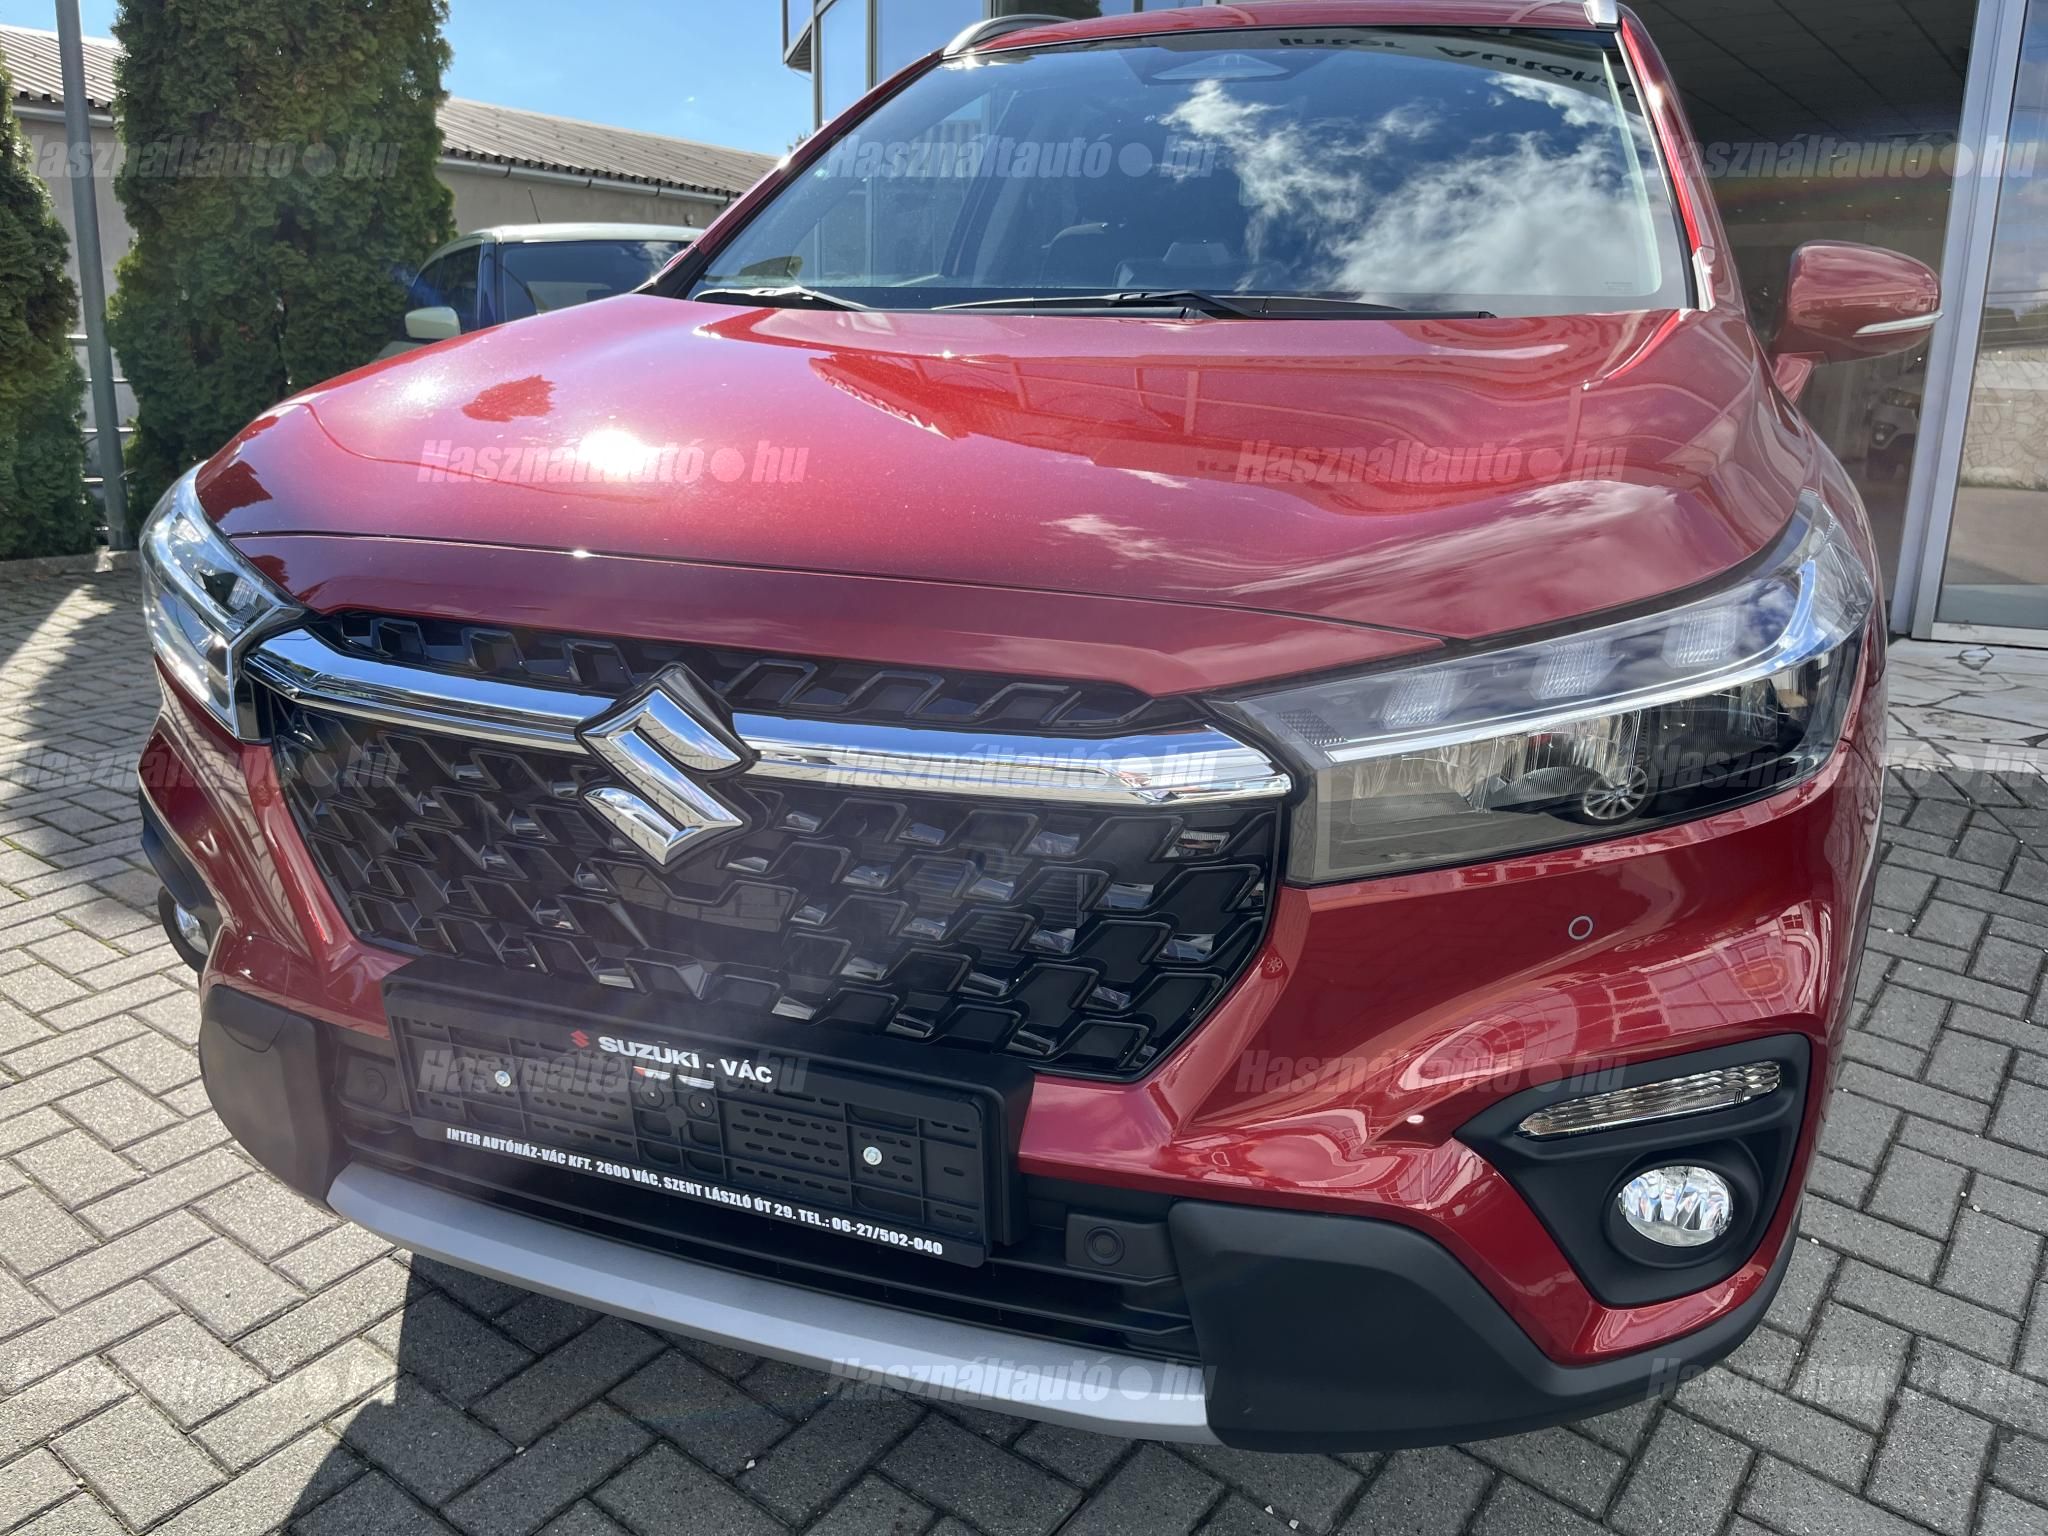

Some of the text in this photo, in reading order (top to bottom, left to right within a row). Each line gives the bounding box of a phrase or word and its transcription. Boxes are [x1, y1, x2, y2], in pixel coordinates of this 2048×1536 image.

[598, 1036, 700, 1069] SUZUKI
[719, 1059, 773, 1084] VÁC
[446, 1127, 481, 1146] INTER
[483, 1135, 566, 1166] AUTÓHÁZ-VÁC
[568, 1154, 593, 1172] KFT.
[596, 1161, 631, 1180] 2600
[664, 1177, 702, 1197] SZENT
[704, 1186, 752, 1210] LÁSZLÓ
[754, 1196, 772, 1215] ÚT
[798, 1208, 830, 1229] TEL.:
[831, 1216, 943, 1256] 06-27/502-040
